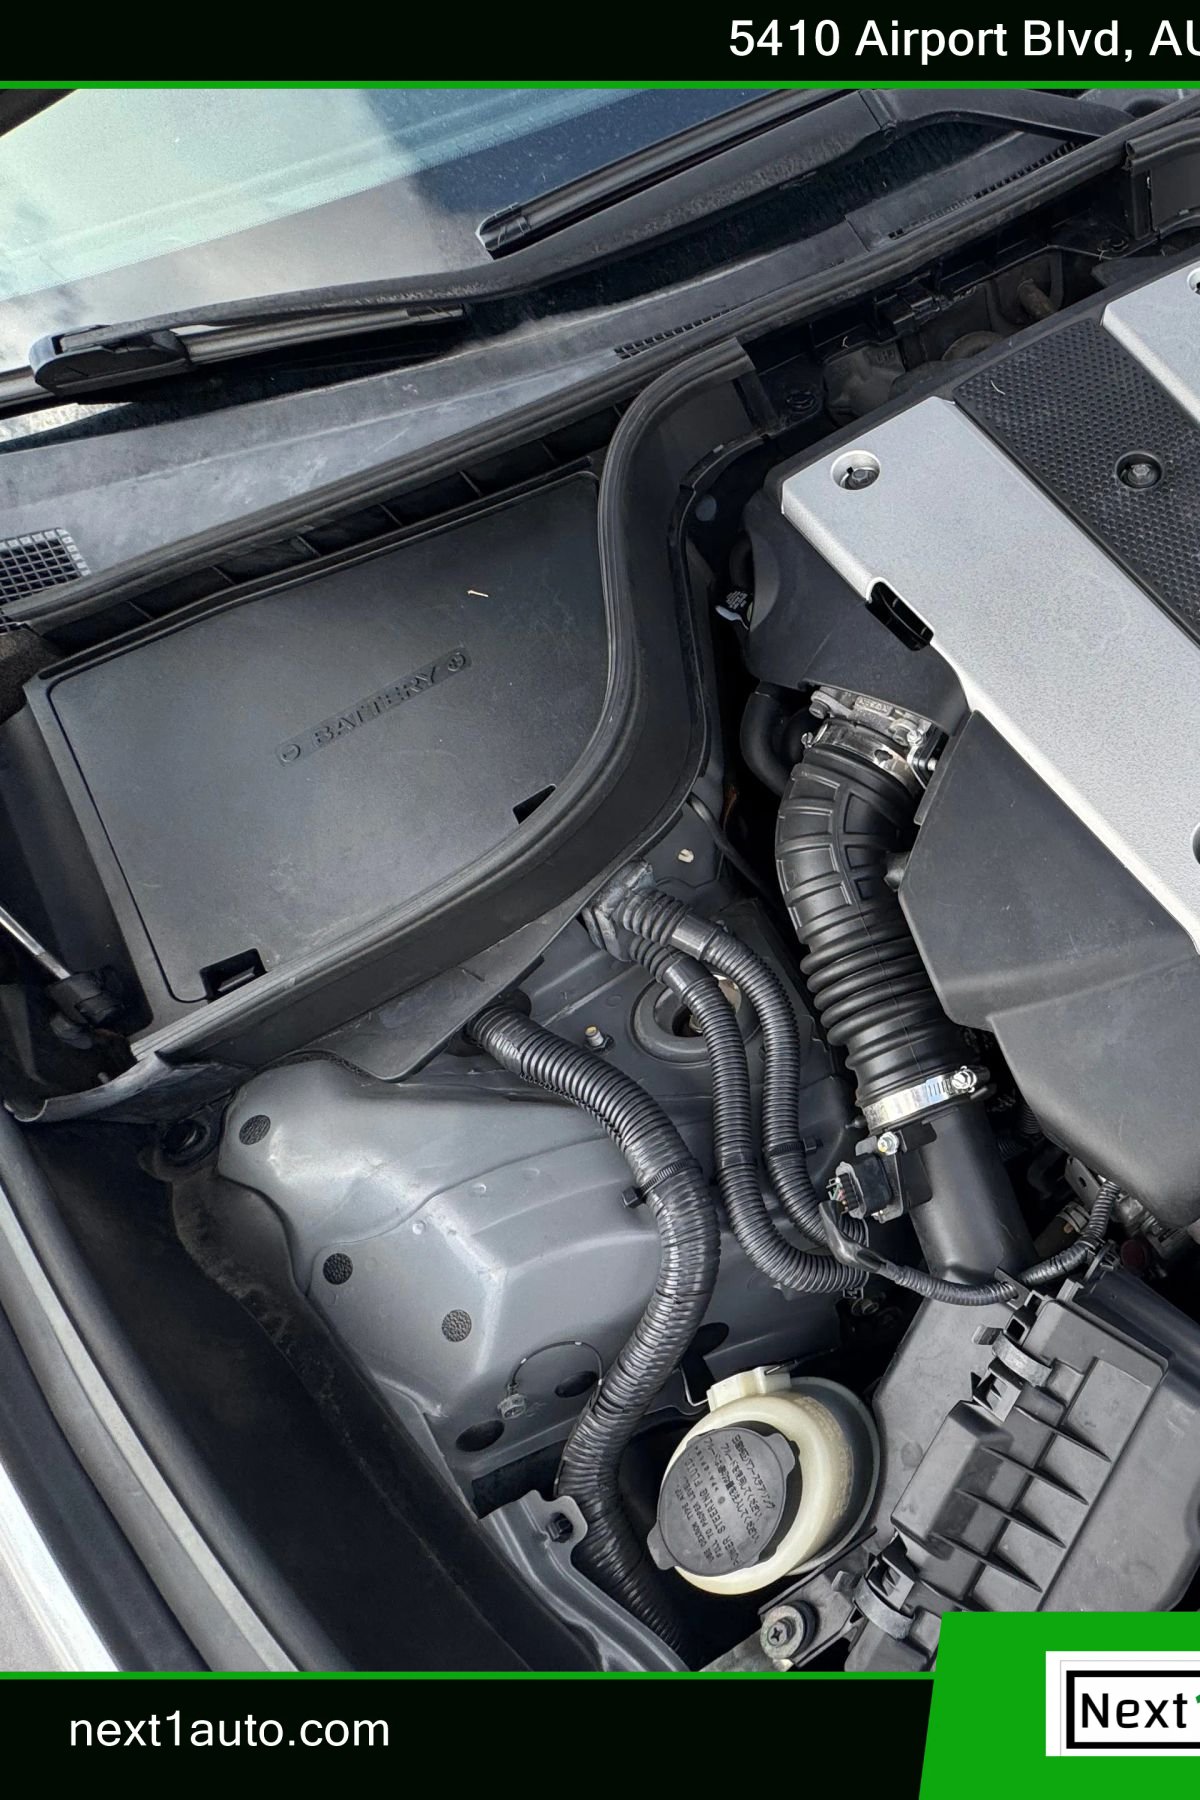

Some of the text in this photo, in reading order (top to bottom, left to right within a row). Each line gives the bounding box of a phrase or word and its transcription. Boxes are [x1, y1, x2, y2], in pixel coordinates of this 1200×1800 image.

[312, 667, 437, 747] BATTERY
[691, 1501, 708, 1527] PROPER
[697, 1487, 726, 1533] STEERING
[704, 1528, 714, 1537] TO
[710, 1539, 724, 1558] FILL
